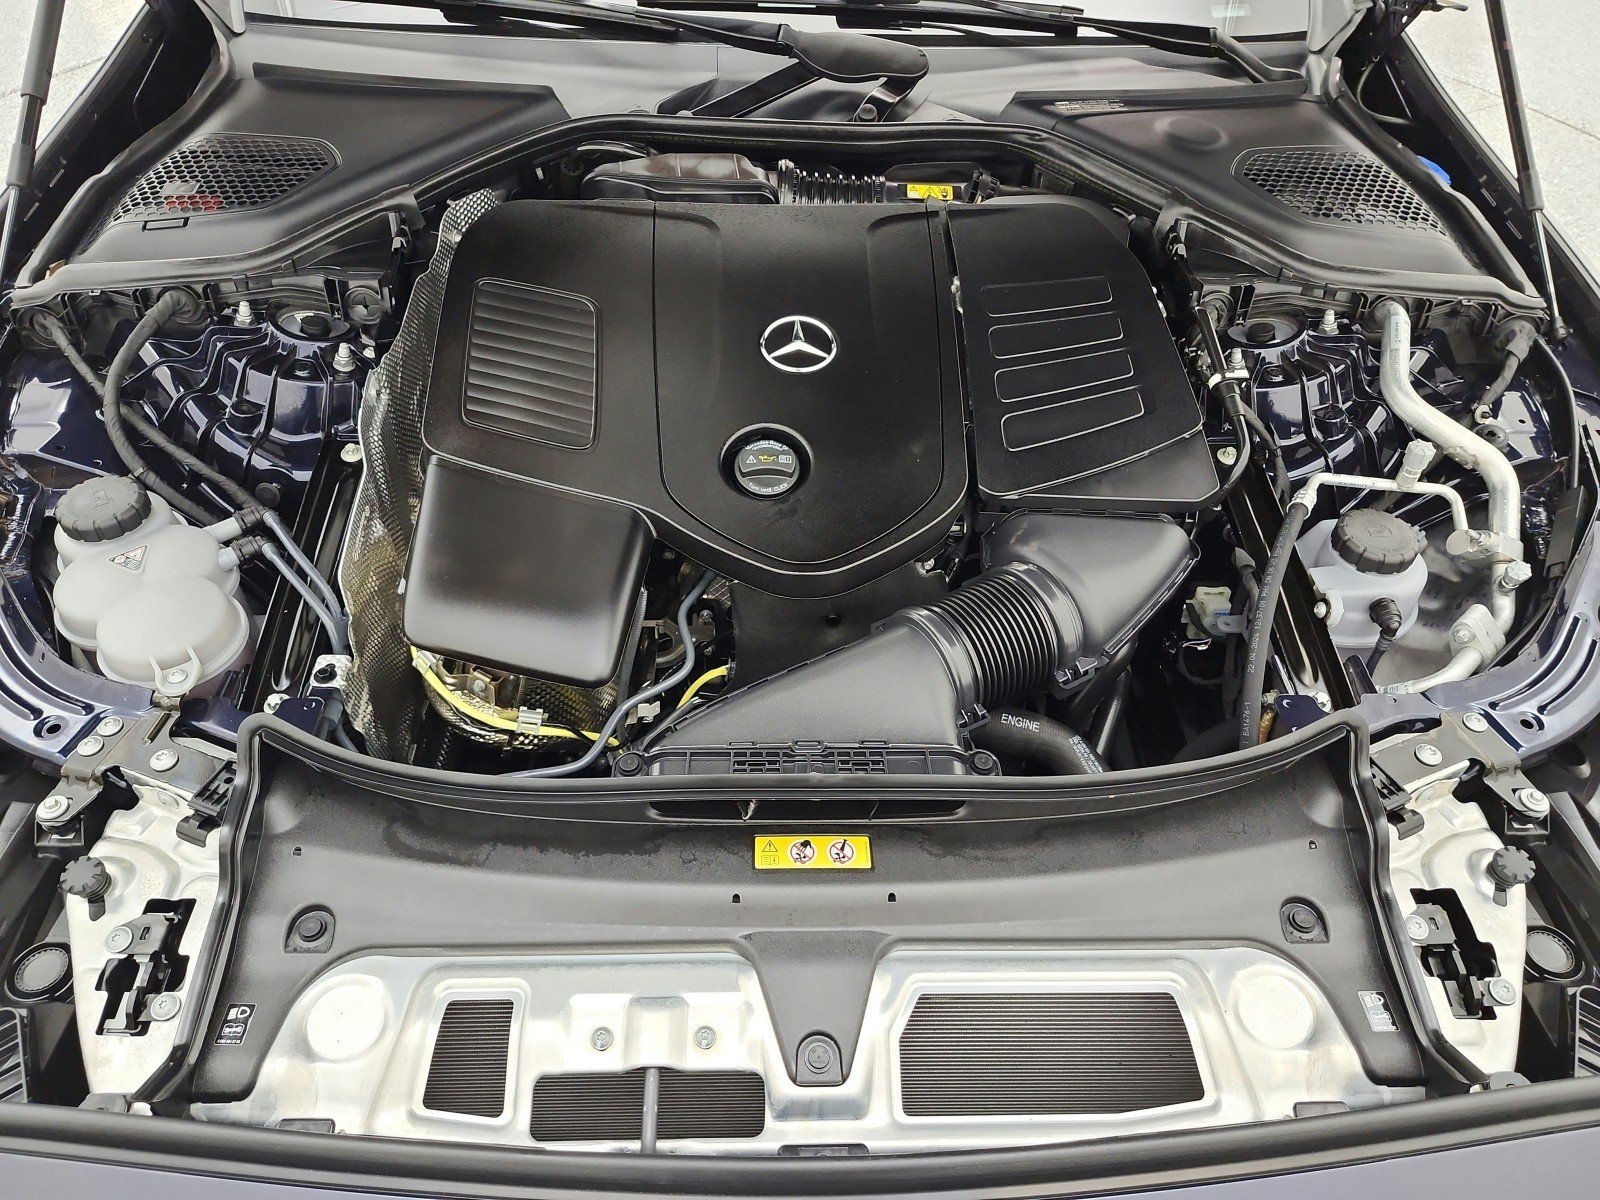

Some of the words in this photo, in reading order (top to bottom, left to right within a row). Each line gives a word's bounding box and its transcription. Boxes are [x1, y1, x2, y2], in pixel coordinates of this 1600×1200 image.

[748, 482, 760, 491] Turn
[773, 482, 789, 492] CLICK
[1247, 633, 1260, 674] 22.04.2024
[1254, 600, 1267, 630] 12:37:01
[1000, 713, 1040, 733] ENGINE
